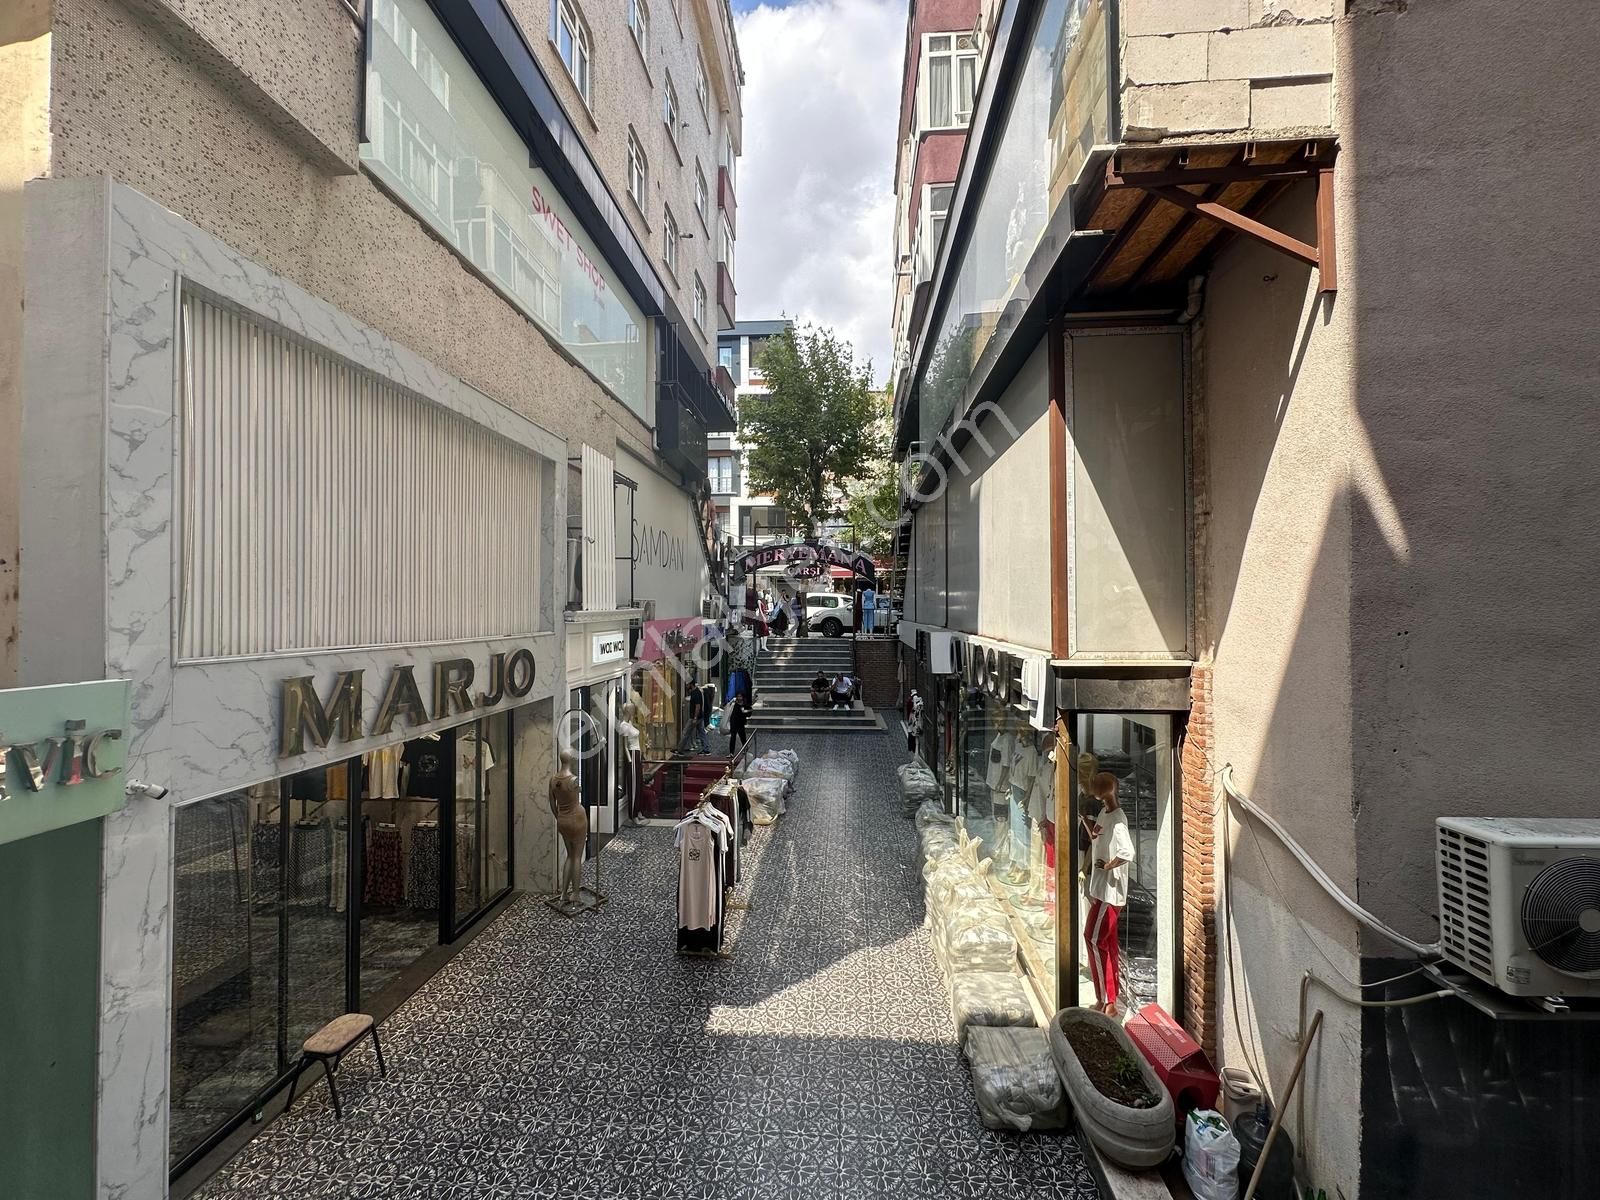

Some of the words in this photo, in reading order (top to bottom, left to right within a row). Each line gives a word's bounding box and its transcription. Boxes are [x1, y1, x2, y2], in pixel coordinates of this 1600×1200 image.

[576, 244, 606, 291] SHOP
[631, 518, 684, 572] ŞAMDAN
[745, 543, 867, 575] MERYEMANA
[279, 648, 536, 759] MARJO
